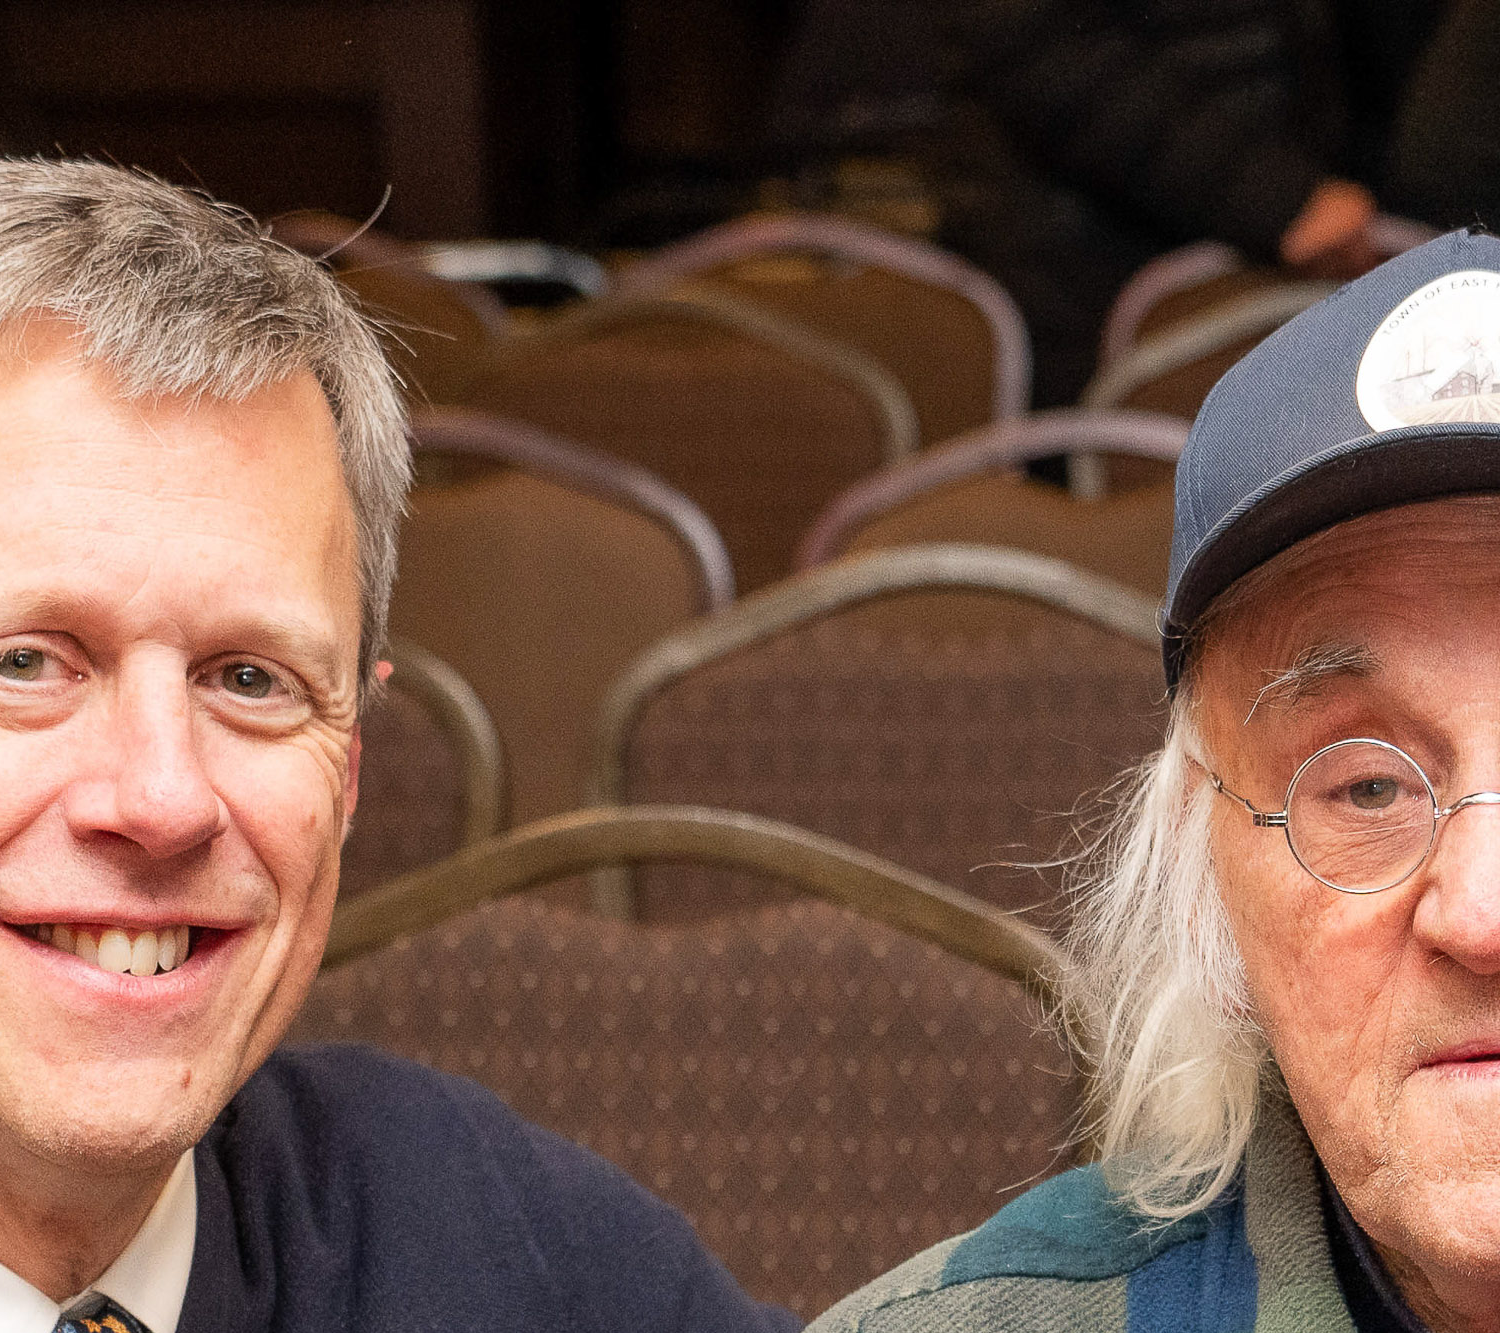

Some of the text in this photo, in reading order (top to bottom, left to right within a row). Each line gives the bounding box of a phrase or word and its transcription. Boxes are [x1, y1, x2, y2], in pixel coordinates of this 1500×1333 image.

[1383, 300, 1420, 335] TOWN
[1424, 286, 1443, 301] OF
[1450, 278, 1489, 290] EAST
